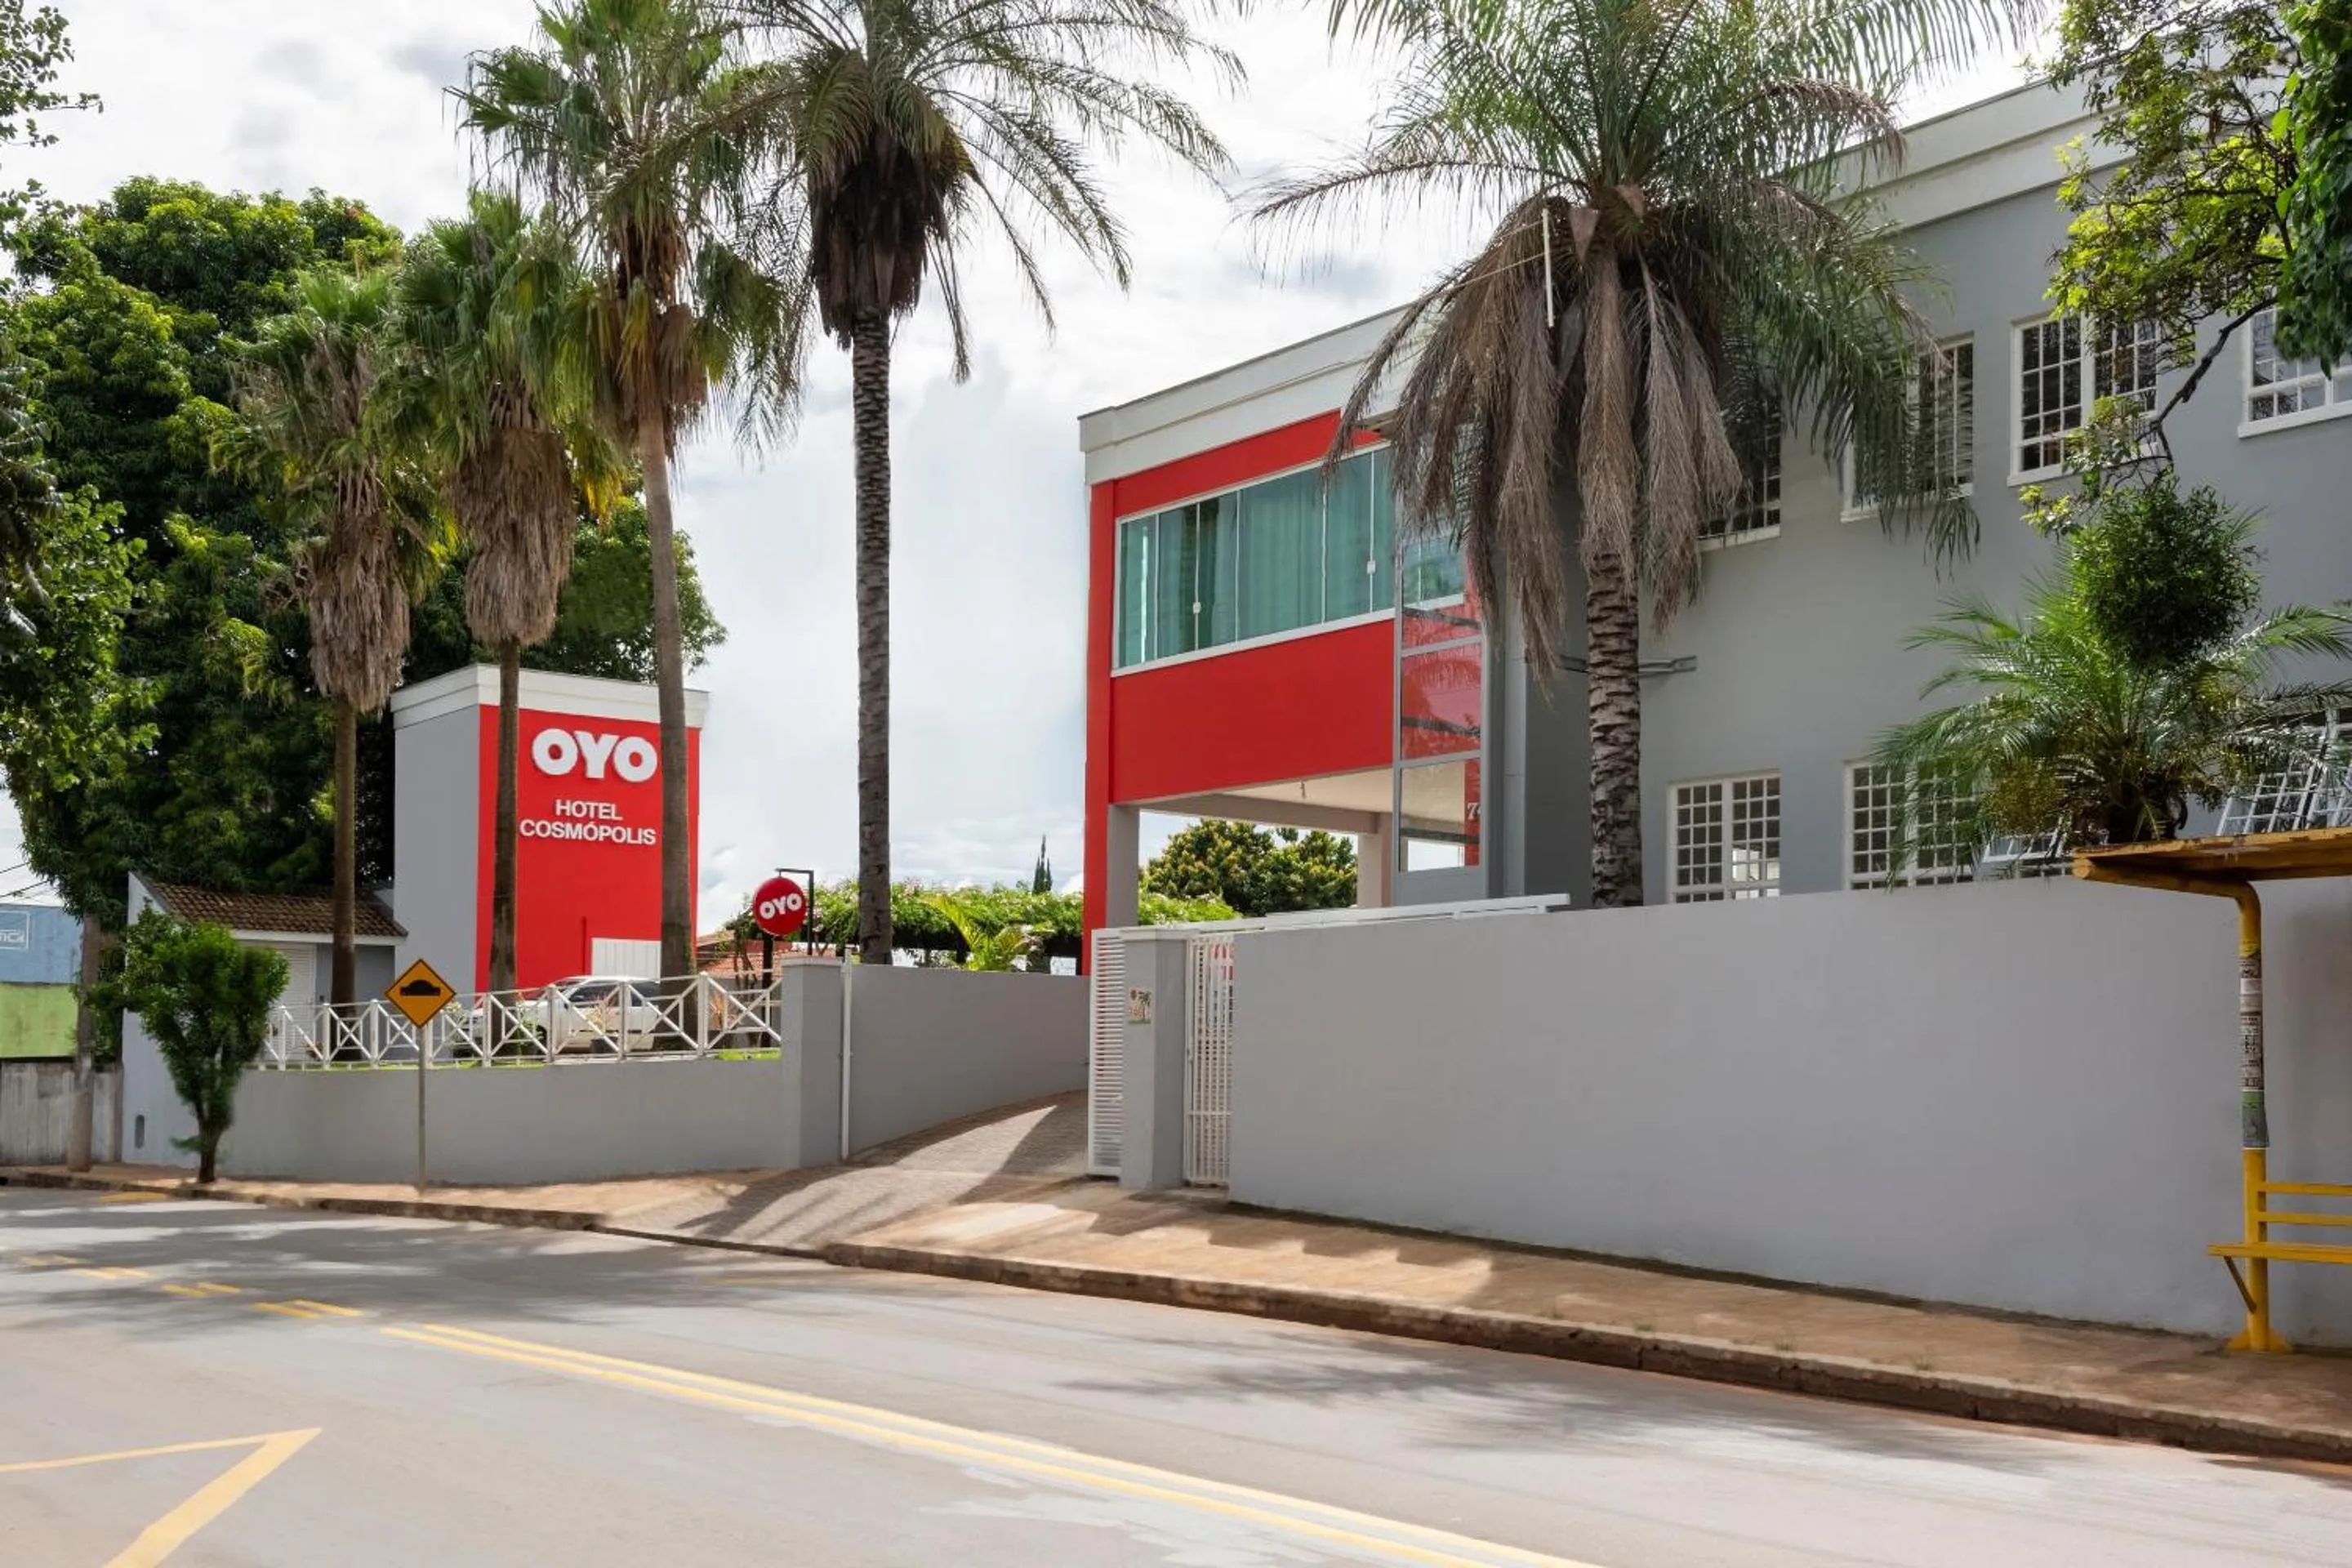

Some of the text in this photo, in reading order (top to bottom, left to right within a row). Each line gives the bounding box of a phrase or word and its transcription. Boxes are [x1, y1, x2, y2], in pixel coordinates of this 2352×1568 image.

[532, 728, 657, 782] OYO
[555, 799, 623, 821] HOTEL
[519, 819, 657, 845] COSMÓPOLIS
[760, 893, 802, 920] OYO
